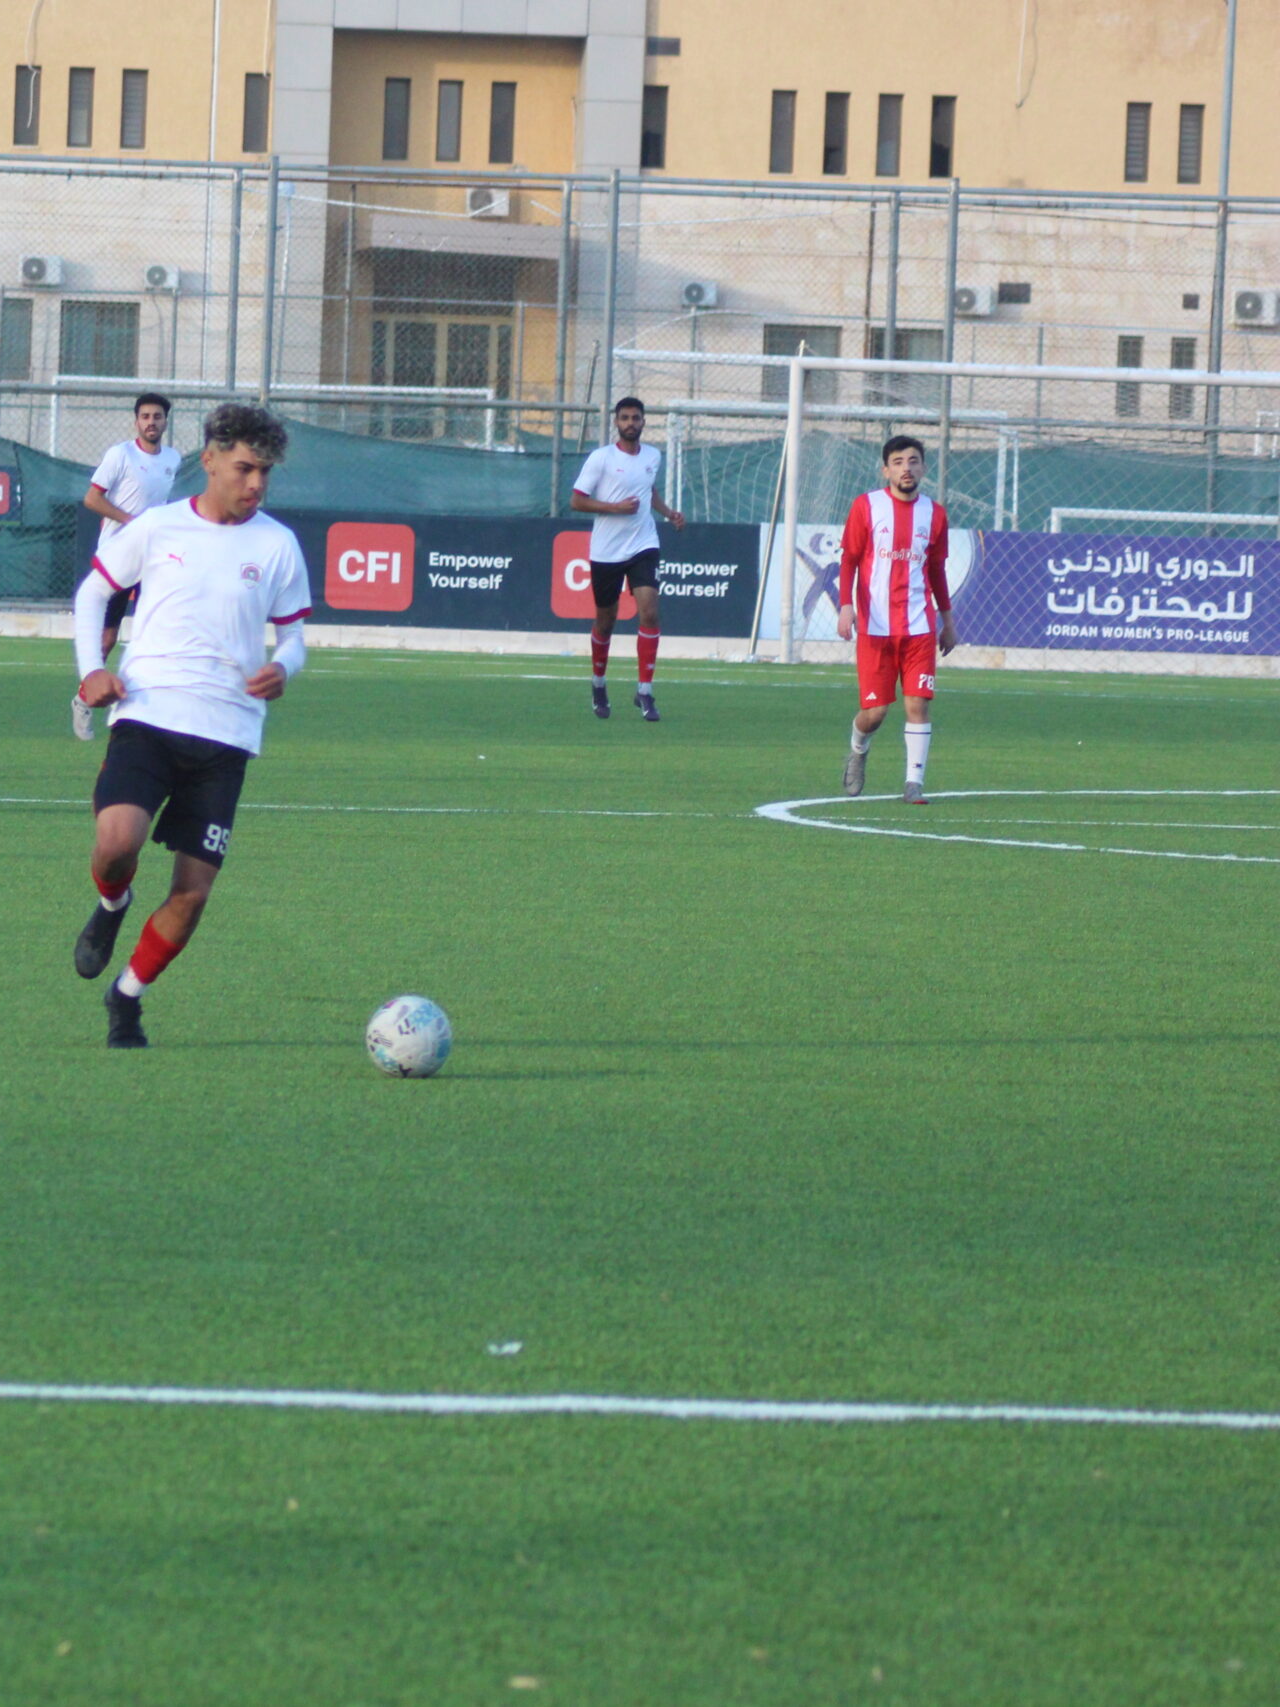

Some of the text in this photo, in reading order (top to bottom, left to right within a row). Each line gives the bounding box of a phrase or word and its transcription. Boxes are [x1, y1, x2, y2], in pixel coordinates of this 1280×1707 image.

[338, 550, 401, 584] CFI
[428, 552, 512, 571] Empower
[659, 560, 738, 579] Empower
[1047, 546, 1254, 587] الدوري الأردني
[428, 573, 503, 590] Yourself
[1046, 586, 1253, 623] للمحترفات
[1045, 623, 1250, 643] JORDAN WOMEN'S PRO-LEAGUE
